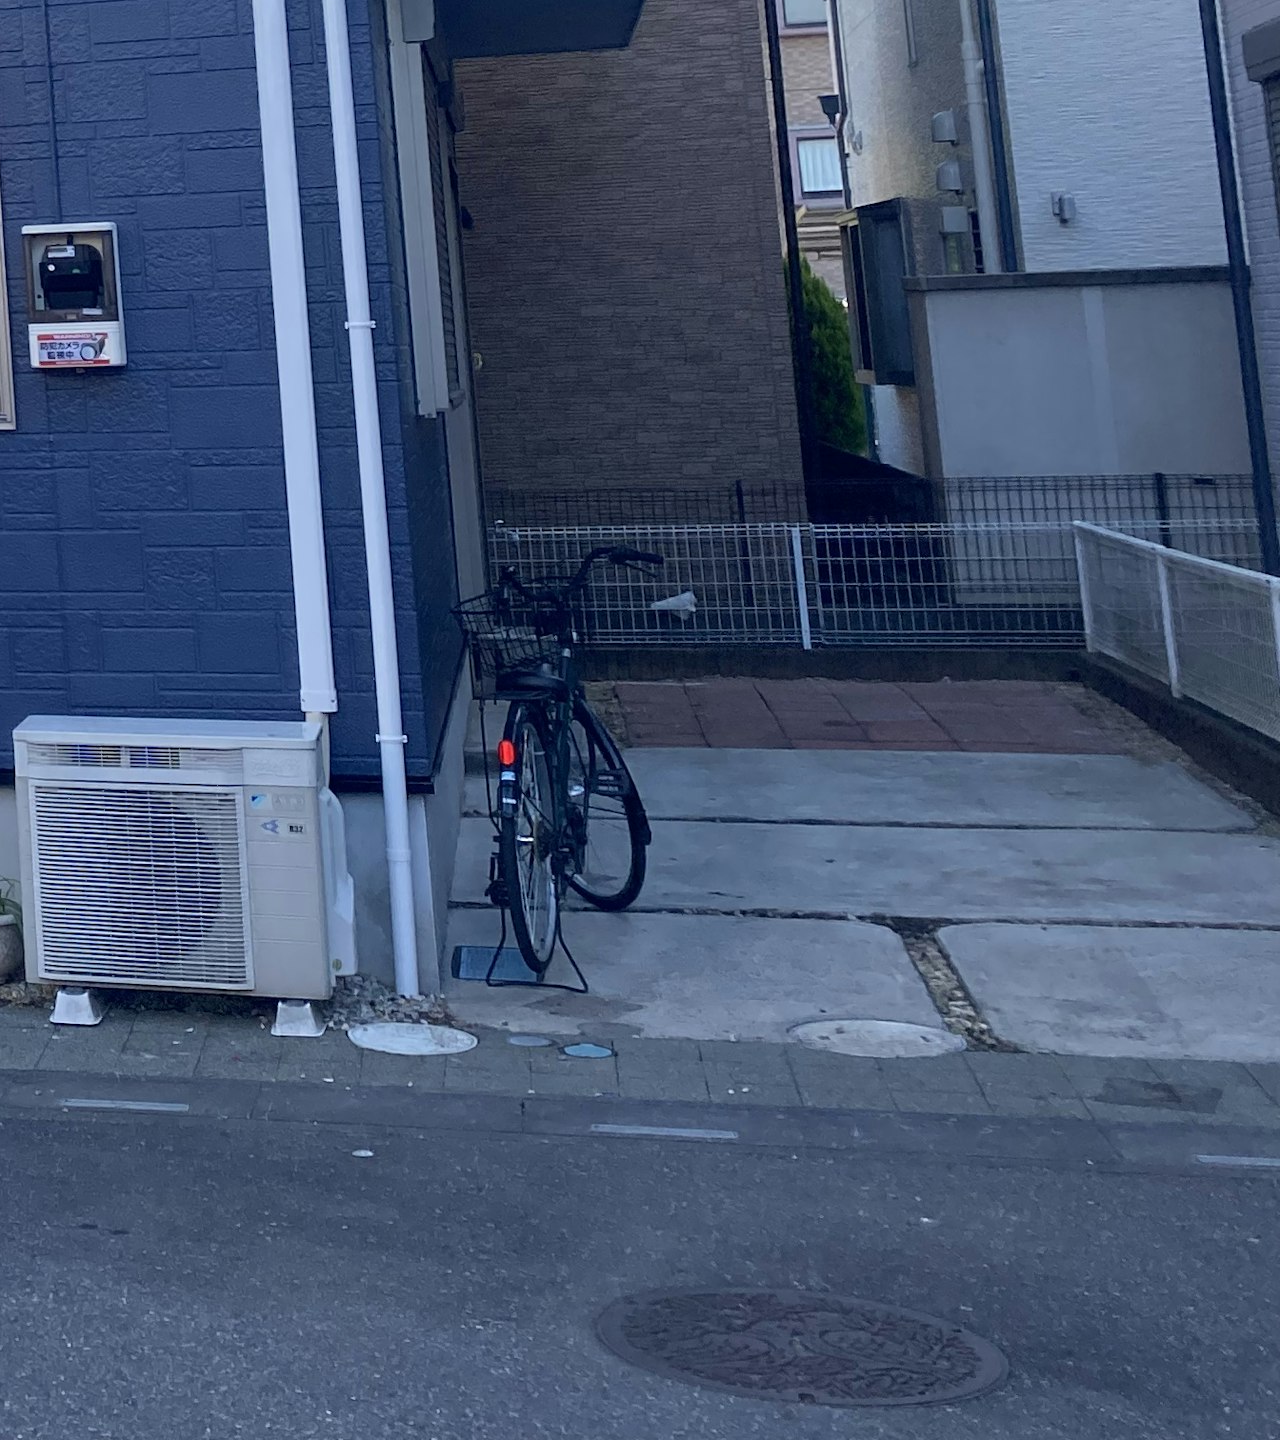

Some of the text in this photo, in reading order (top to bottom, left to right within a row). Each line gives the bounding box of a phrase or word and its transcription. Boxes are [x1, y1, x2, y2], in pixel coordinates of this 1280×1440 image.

[40, 342, 79, 350] 防犯カメラ
